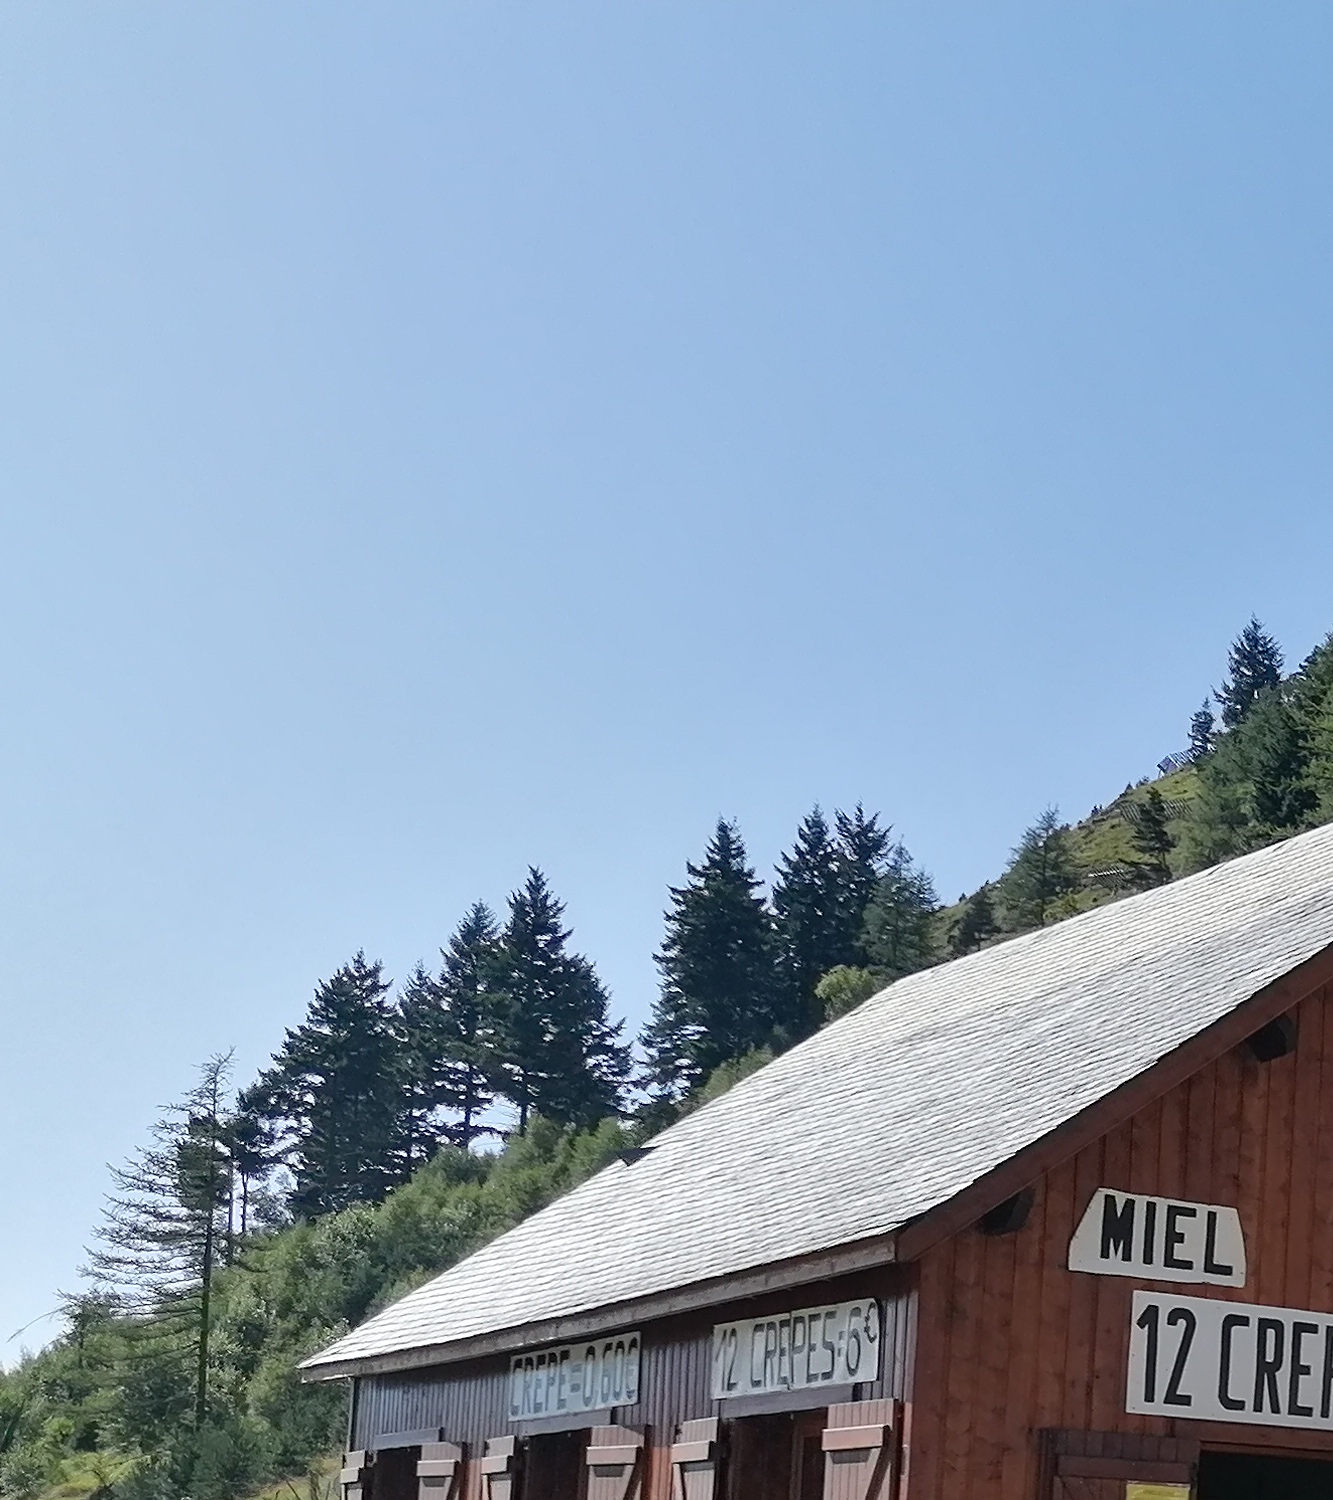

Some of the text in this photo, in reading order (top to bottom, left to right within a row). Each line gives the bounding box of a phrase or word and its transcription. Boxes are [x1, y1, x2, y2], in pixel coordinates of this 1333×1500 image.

[1100, 1194, 1233, 1277] MIEL
[715, 1327, 739, 1392] 12
[1136, 1303, 1197, 1407] 12
